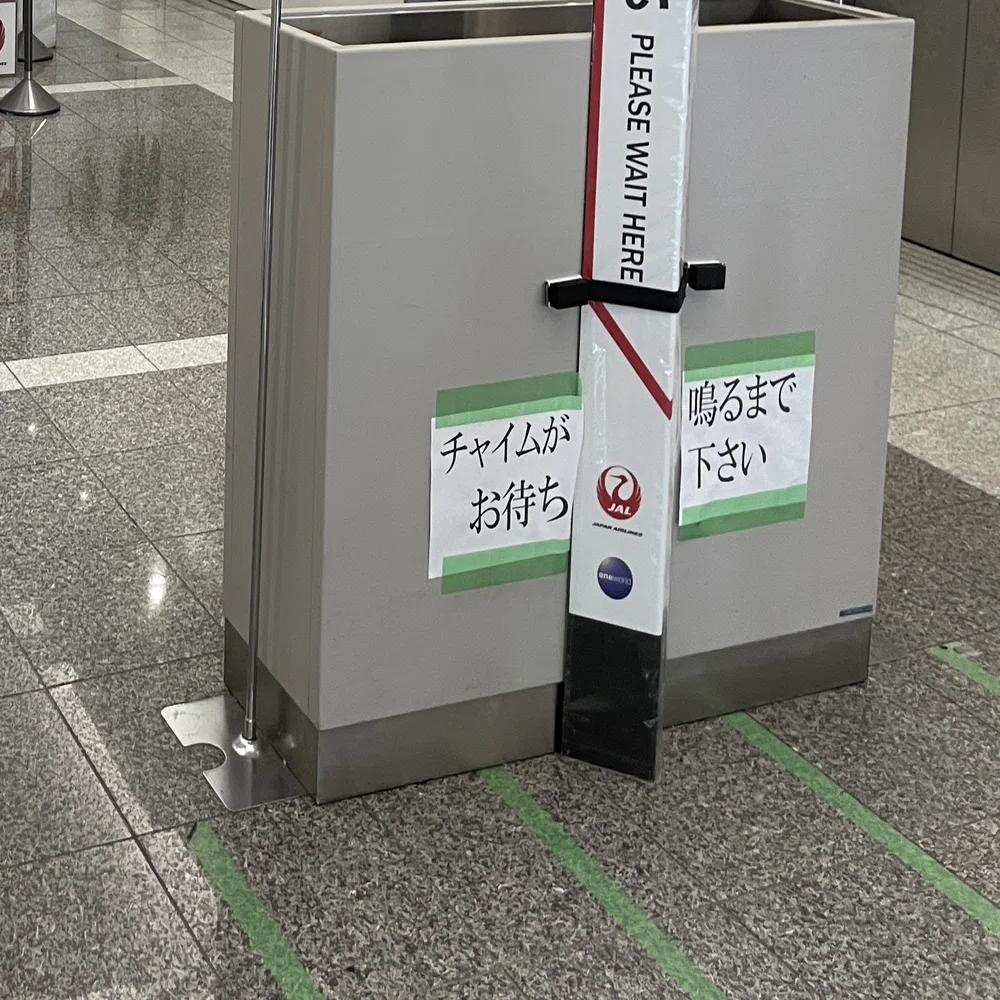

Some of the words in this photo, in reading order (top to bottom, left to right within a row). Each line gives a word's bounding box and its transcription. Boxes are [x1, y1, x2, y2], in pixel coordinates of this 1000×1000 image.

[627, 33, 655, 133] PLEASE
[624, 141, 650, 207] WAIT
[620, 213, 646, 283] HERE
[440, 413, 571, 474] チャイムが
[688, 372, 797, 427] 鳴るまで
[469, 475, 569, 534] お待ち
[687, 437, 767, 489] 下さい
[607, 503, 632, 516] JAL
[592, 522, 612, 530] JAPAN
[613, 526, 643, 537] AIRLINES
[598, 571, 632, 586] oneworld
